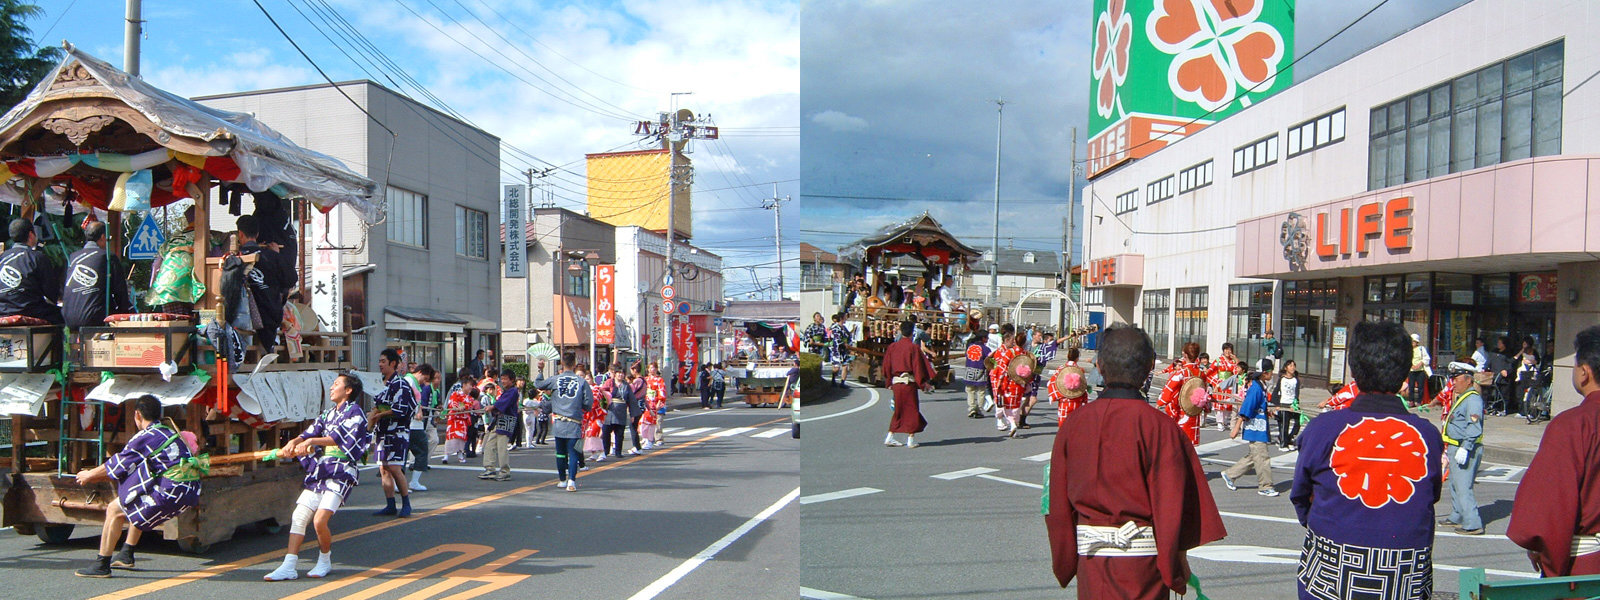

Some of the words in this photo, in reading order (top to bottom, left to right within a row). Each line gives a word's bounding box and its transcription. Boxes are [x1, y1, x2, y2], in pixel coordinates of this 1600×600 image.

[1091, 123, 1126, 174] LIFE
[509, 187, 520, 273] 北総開発株式会社
[1316, 196, 1412, 257] LIFE
[598, 267, 611, 327] らーめん
[663, 289, 672, 297] 40
[1090, 257, 1115, 284] LIFE
[1329, 416, 1428, 509] 祭
